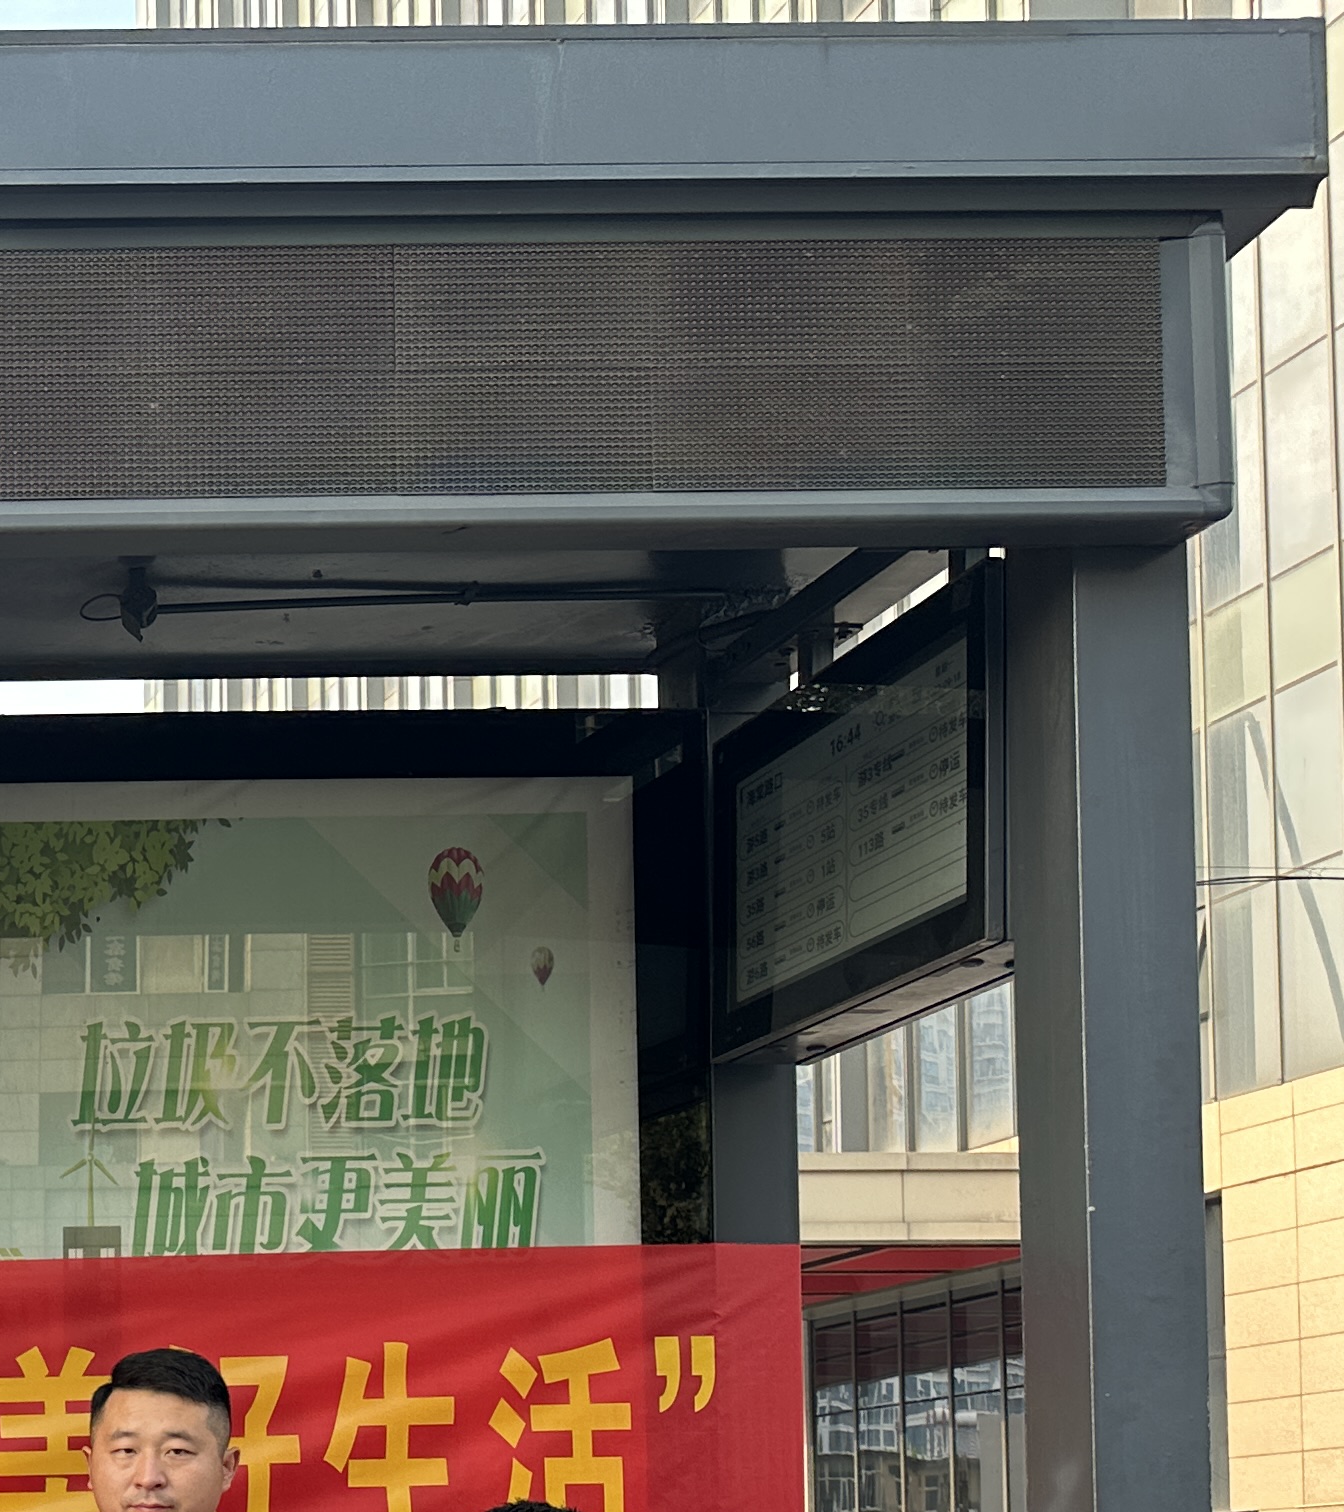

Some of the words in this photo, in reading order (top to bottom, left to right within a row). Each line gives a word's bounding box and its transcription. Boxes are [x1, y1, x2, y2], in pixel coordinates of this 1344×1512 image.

[829, 723, 862, 757] 16:44
[71, 1012, 489, 1132] 垃圾不落地
[131, 1148, 546, 1257] 城市更美丽
